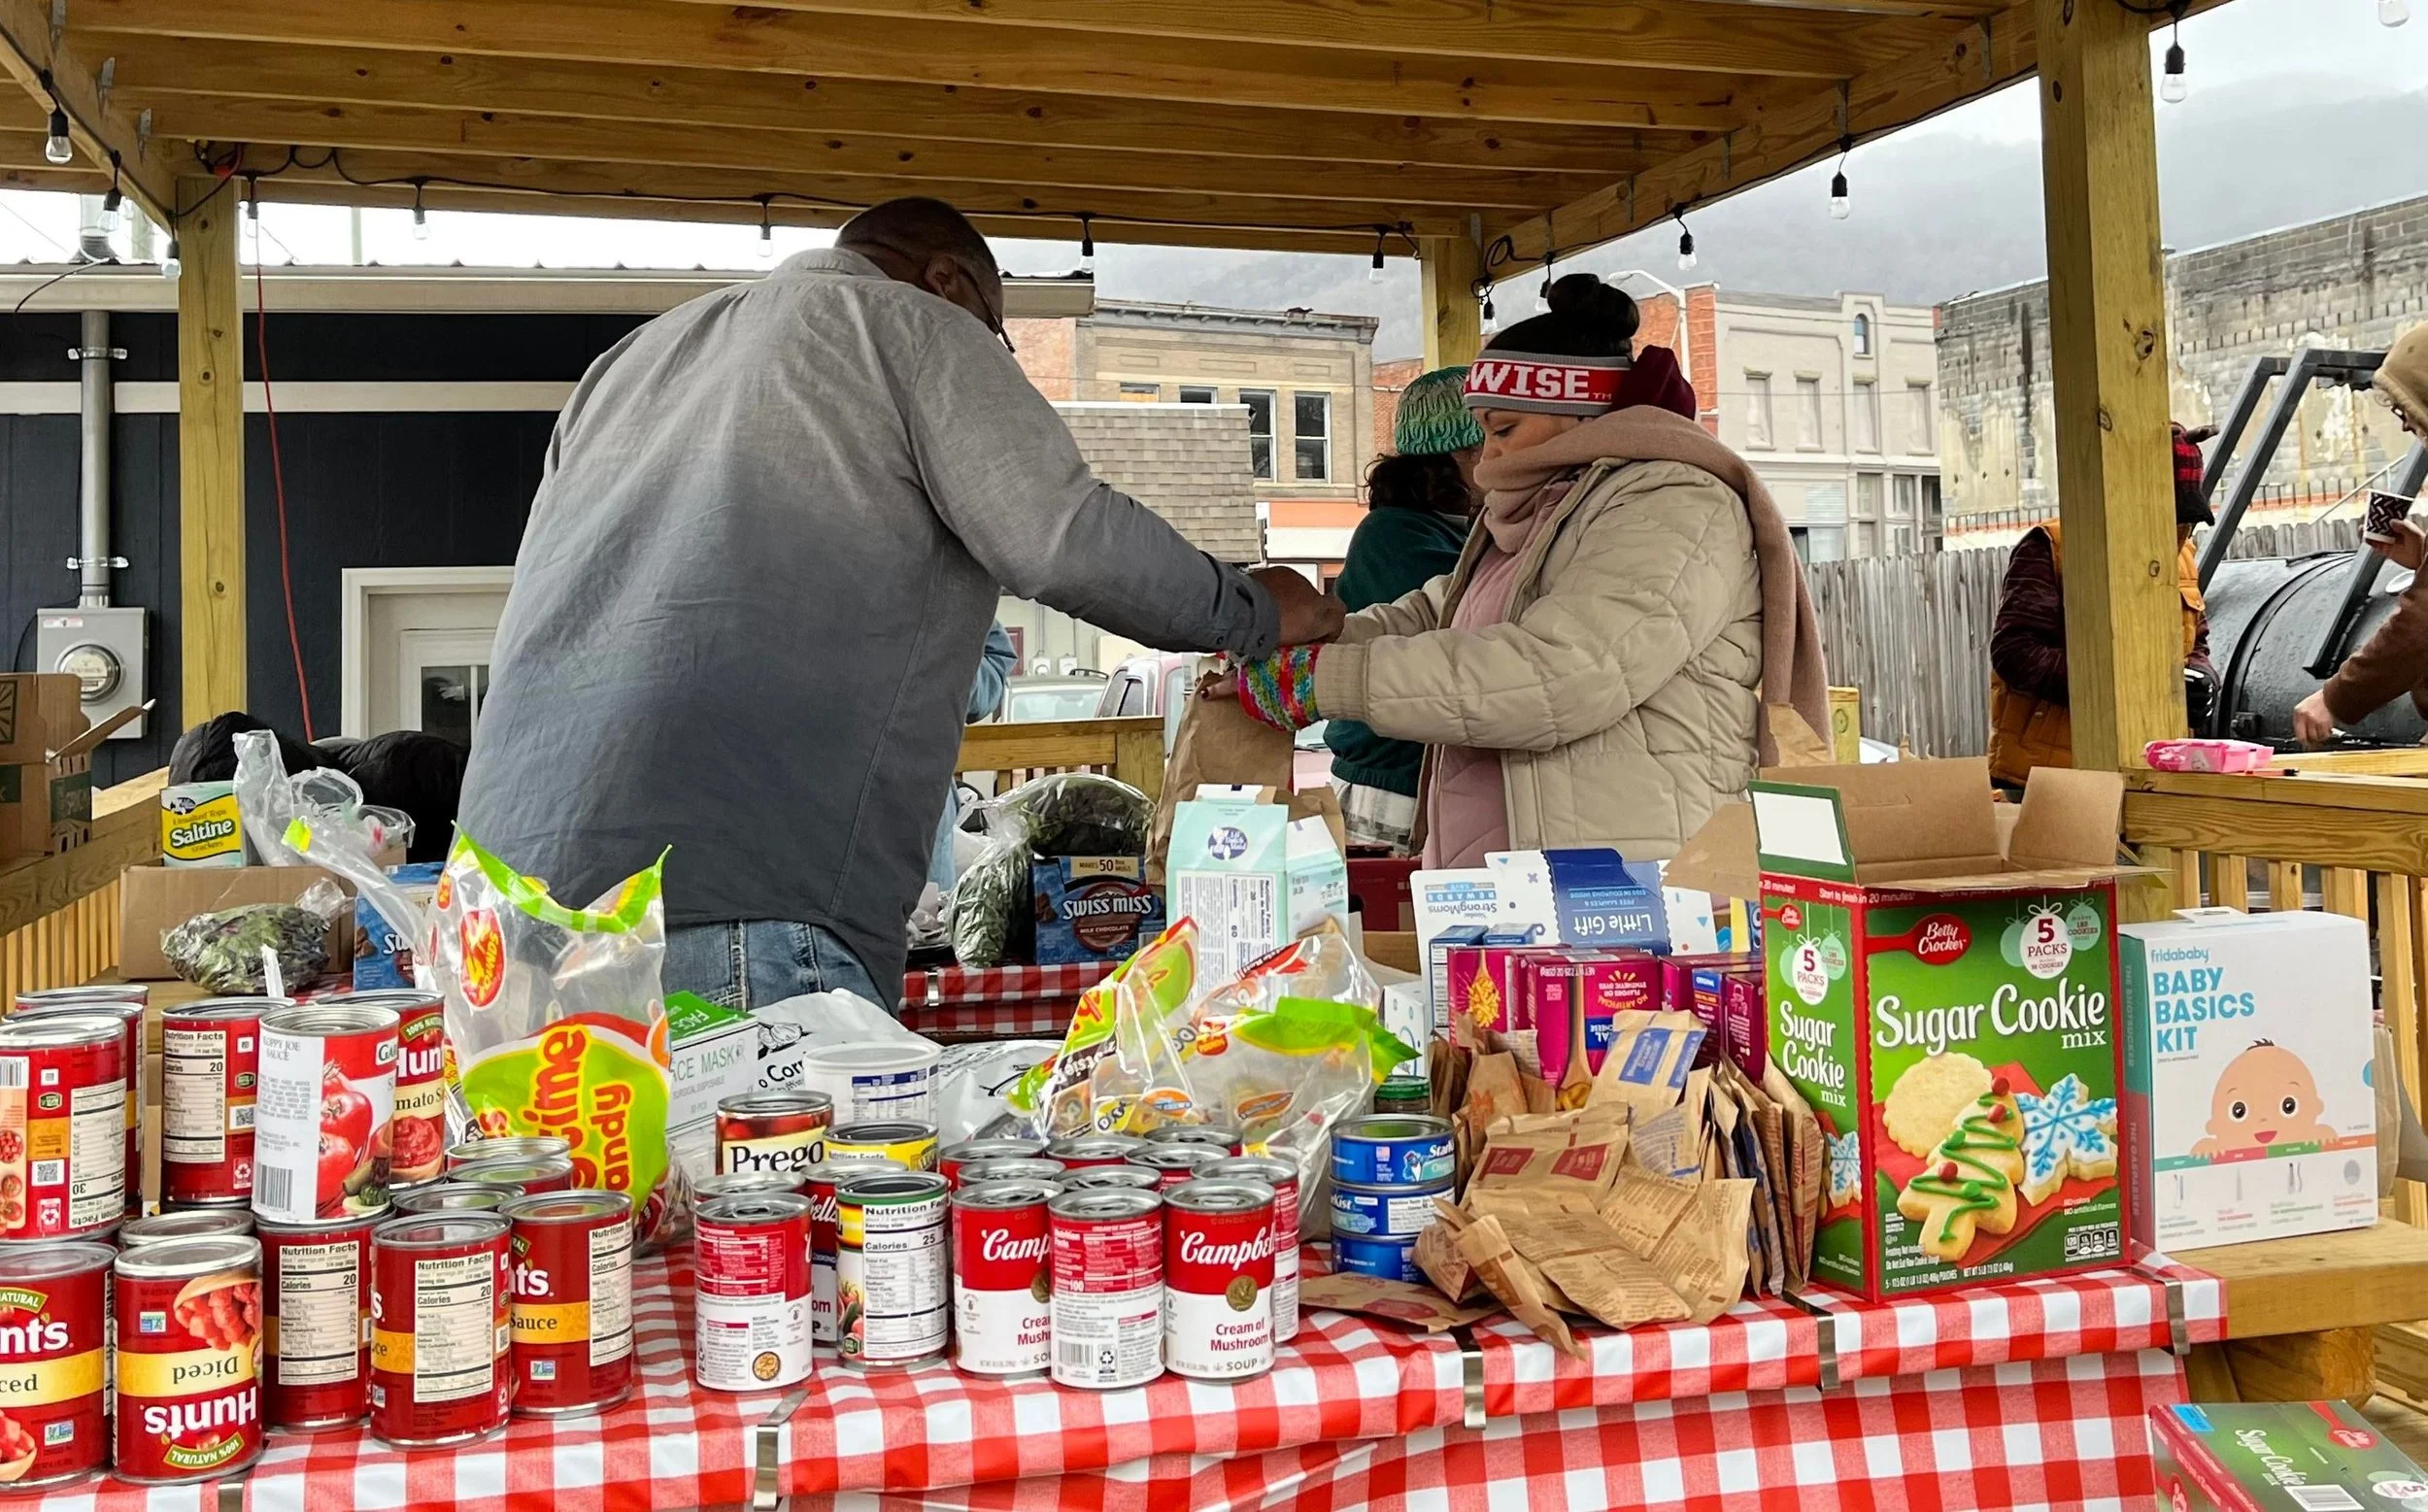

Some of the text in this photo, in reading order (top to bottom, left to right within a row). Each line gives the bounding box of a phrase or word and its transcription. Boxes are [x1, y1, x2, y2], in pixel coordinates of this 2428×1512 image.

[1469, 362, 1590, 399] WISE
[171, 820, 233, 847] Saltine
[1098, 859, 1114, 872] 50
[1428, 901, 1498, 914] StrongMoms
[1869, 892, 1880, 904] 20
[1573, 913, 1654, 936] Little Gift
[1927, 922, 1958, 940] Betty
[2037, 918, 2055, 944] 5
[1918, 936, 1964, 956] Crocker
[2027, 943, 2068, 958] PACKS
[2150, 947, 2209, 963] fridababy
[1803, 949, 1815, 972] 5
[1797, 972, 1825, 986] PACKS
[2152, 966, 2224, 996] BABY
[1991, 977, 2106, 1036] Cookie
[2155, 991, 2255, 1025] BASICS
[1780, 999, 1837, 1052] Sugar
[1876, 994, 1985, 1057] Sugar
[285, 1039, 301, 1053] JOE
[1595, 1032, 1609, 1042] AL
[2061, 1026, 2107, 1050] mix
[2156, 1025, 2198, 1054] KIT
[210, 1062, 223, 1073] 20
[396, 1046, 443, 1079] Hun
[670, 1048, 735, 1082] ACE MASK
[766, 1059, 804, 1083] Cor
[1783, 1040, 1844, 1089] Cookie
[396, 1095, 432, 1111] mato
[1821, 1089, 1847, 1107] mix
[590, 1083, 631, 1192] andy
[729, 1139, 824, 1173] Prego
[1429, 1138, 1455, 1159] StarK
[73, 1183, 86, 1194] 30
[865, 1203, 927, 1216] Nutrition
[281, 1243, 357, 1257] Nutrition Facts
[865, 1234, 936, 1251] Calories 25
[981, 1227, 1052, 1263] Camp
[418, 1260, 465, 1271] Nutrition
[468, 1254, 492, 1266] Facts
[281, 1273, 356, 1290] Calories 20
[1068, 1280, 1084, 1293] 100
[418, 1284, 491, 1305] Calories 20
[510, 1311, 557, 1330] Sauce
[1022, 1315, 1051, 1329] Crea
[1215, 1316, 1265, 1336] Cream of
[1017, 1330, 1051, 1346] Mush
[1210, 1333, 1268, 1351] Mushroom
[172, 1355, 240, 1385] Diced
[1227, 1359, 1258, 1371] SOUP
[0, 1373, 39, 1393] ced
[171, 1439, 240, 1465] 100% NATURAL
